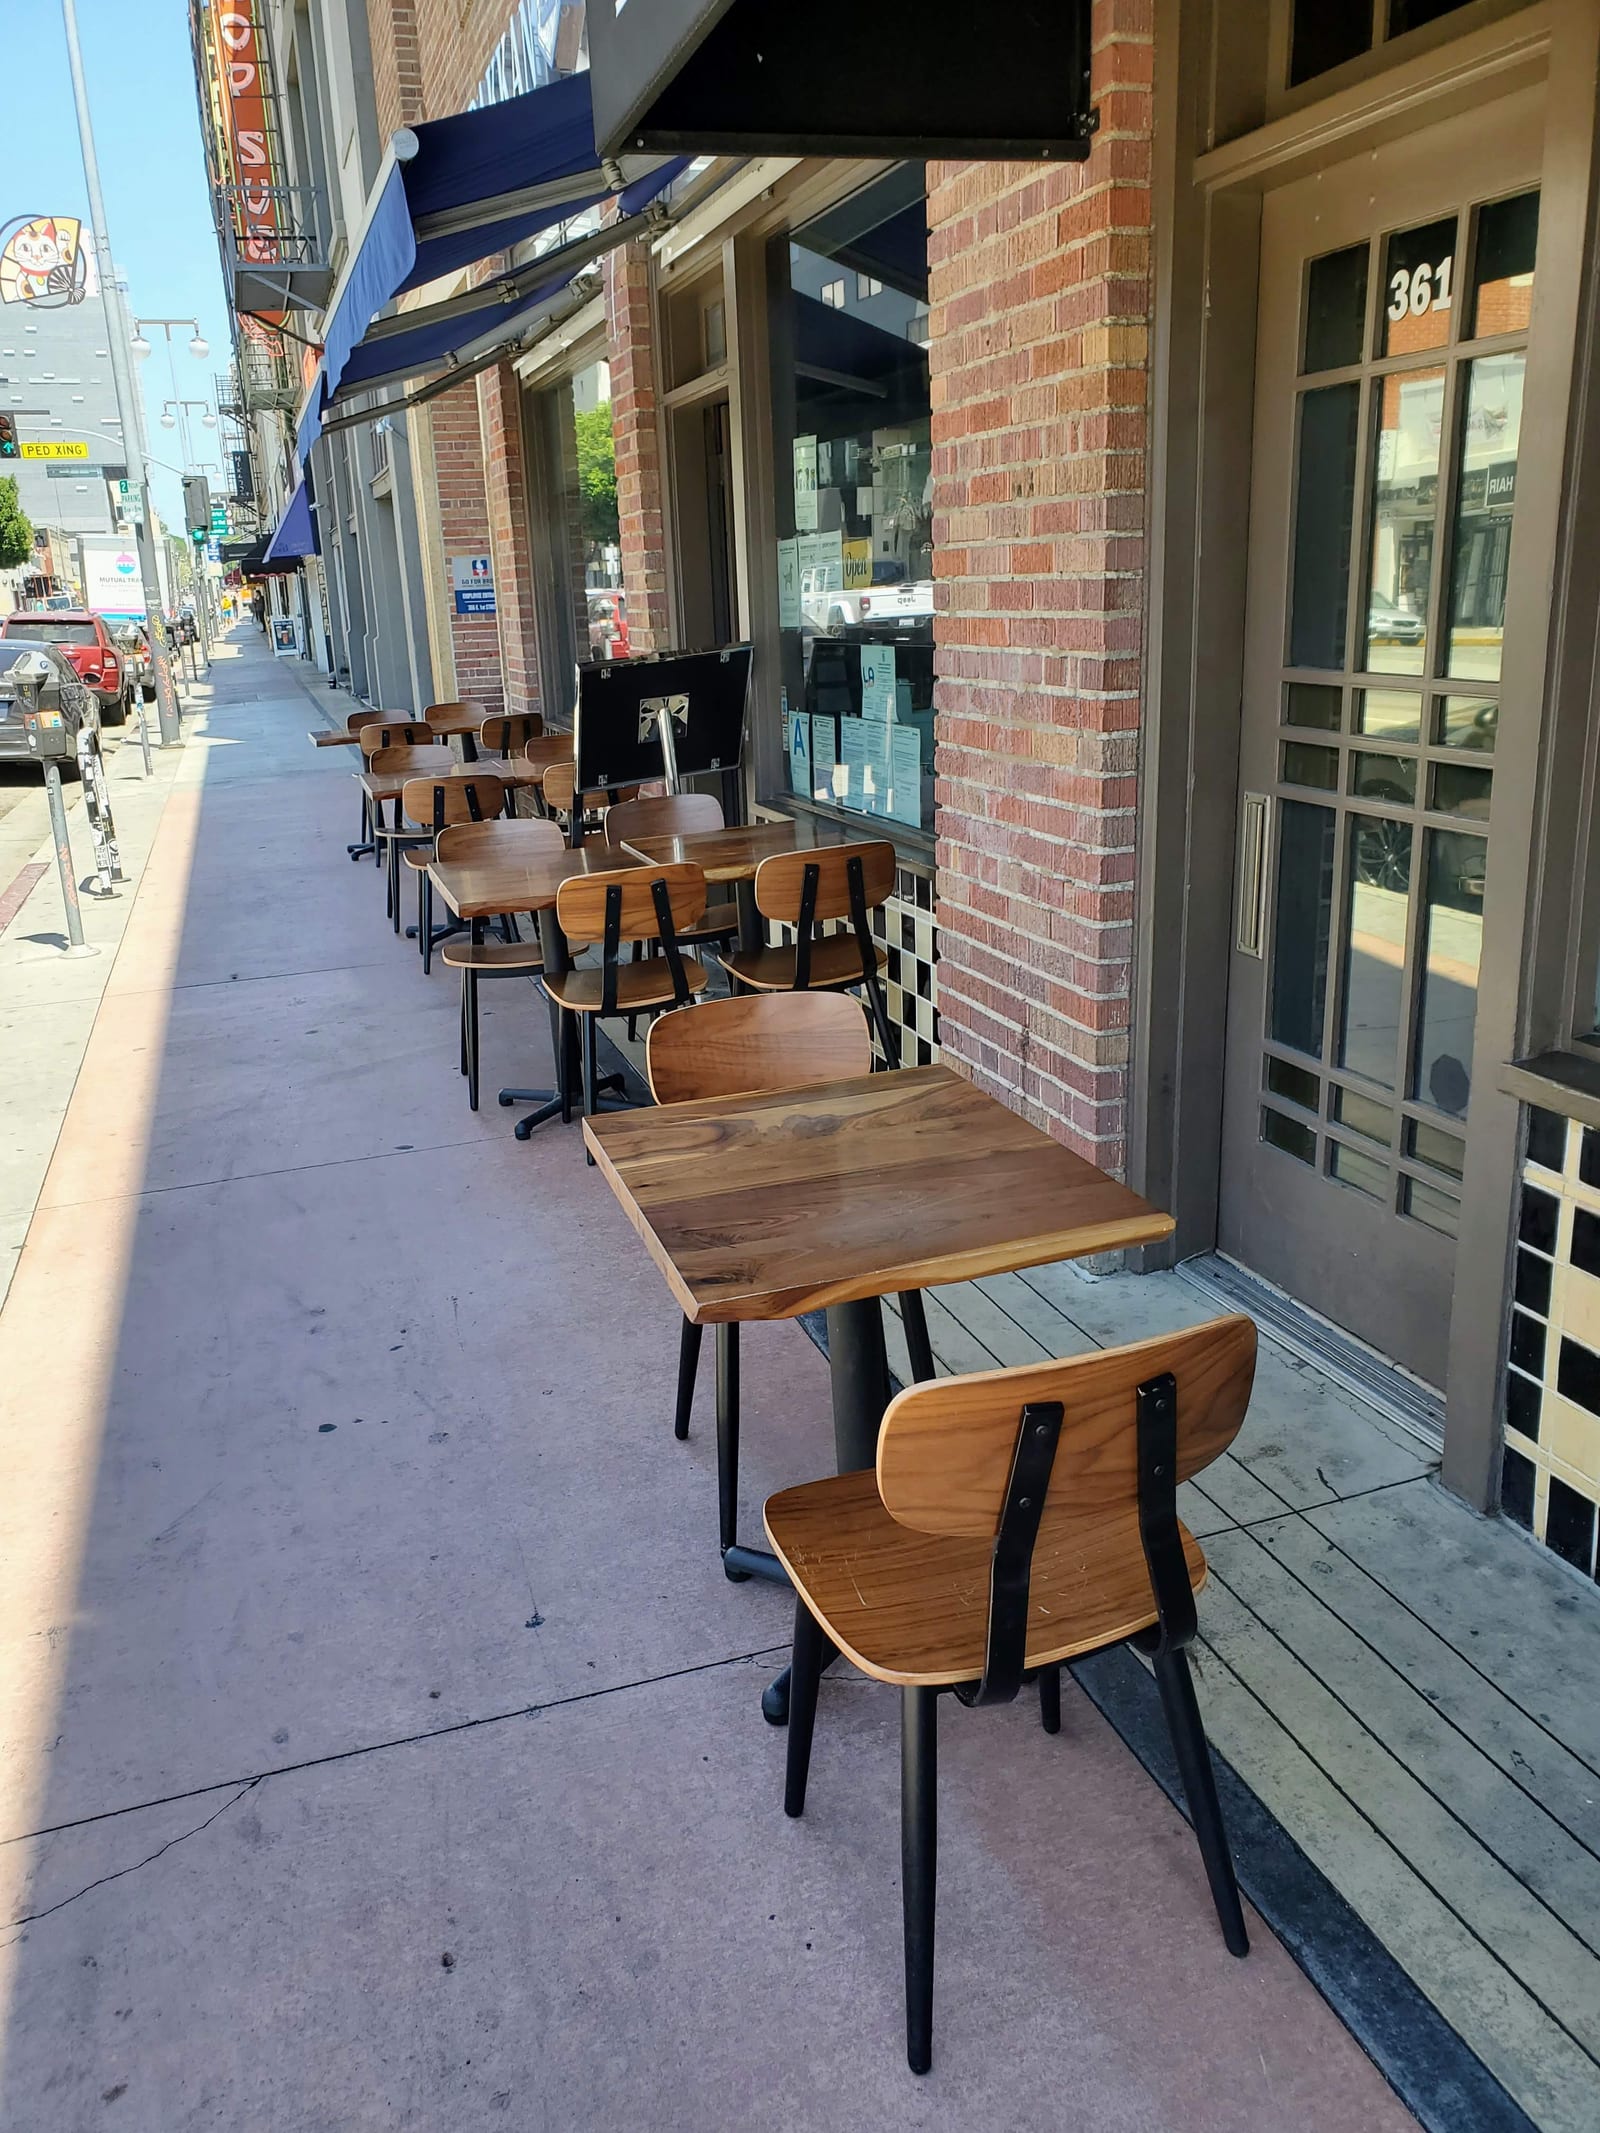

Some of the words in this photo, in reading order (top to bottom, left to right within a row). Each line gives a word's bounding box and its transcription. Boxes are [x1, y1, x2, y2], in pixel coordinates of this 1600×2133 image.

[237, 131, 277, 263] SUE
[1387, 255, 1453, 321] 361
[27, 445, 50, 456] PED
[56, 444, 82, 456] XING
[121, 481, 127, 492] 2
[845, 551, 868, 585] Open
[793, 717, 806, 758] A
